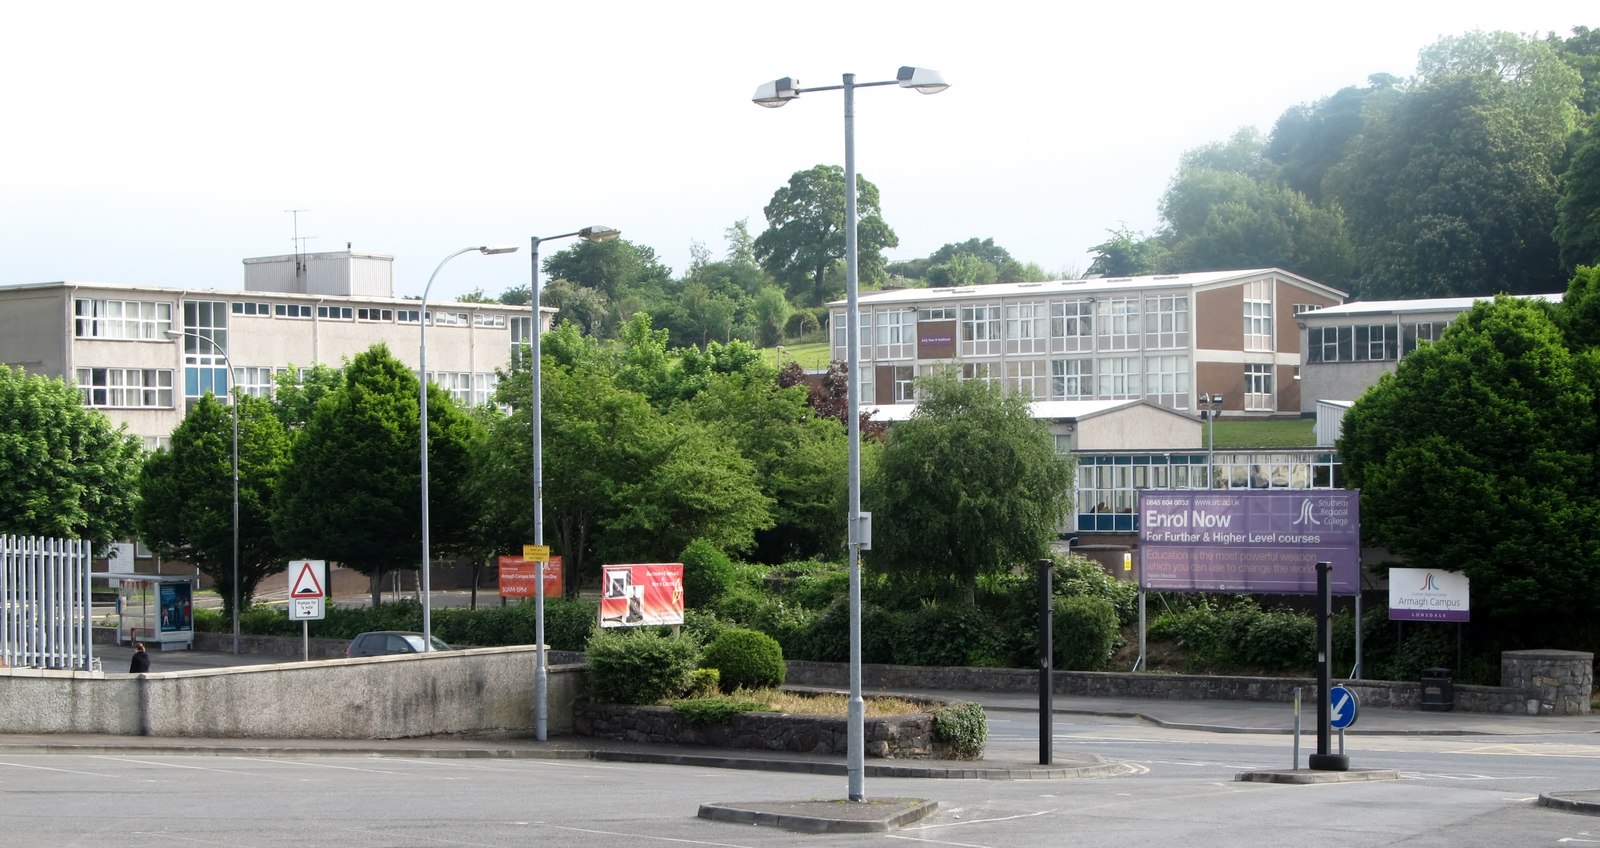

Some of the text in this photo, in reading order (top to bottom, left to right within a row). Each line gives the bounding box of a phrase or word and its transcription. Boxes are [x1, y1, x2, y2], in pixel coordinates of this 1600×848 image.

[1320, 508, 1348, 516] Regional
[1146, 510, 1231, 528] Enrol Now
[1324, 517, 1348, 527] College
[1147, 532, 1320, 544] For Further & Higher Level courses
[1147, 550, 1188, 560] Education
[1200, 551, 1213, 560] the
[1216, 552, 1237, 560] most
[1240, 552, 1278, 564] powerful
[1281, 554, 1316, 564] weapon
[1147, 562, 1170, 572] which
[1174, 564, 1188, 574] you
[1227, 563, 1236, 572] to
[1239, 563, 1271, 575] change
[1274, 564, 1288, 573] the
[1399, 597, 1460, 608] Armagh Campus
